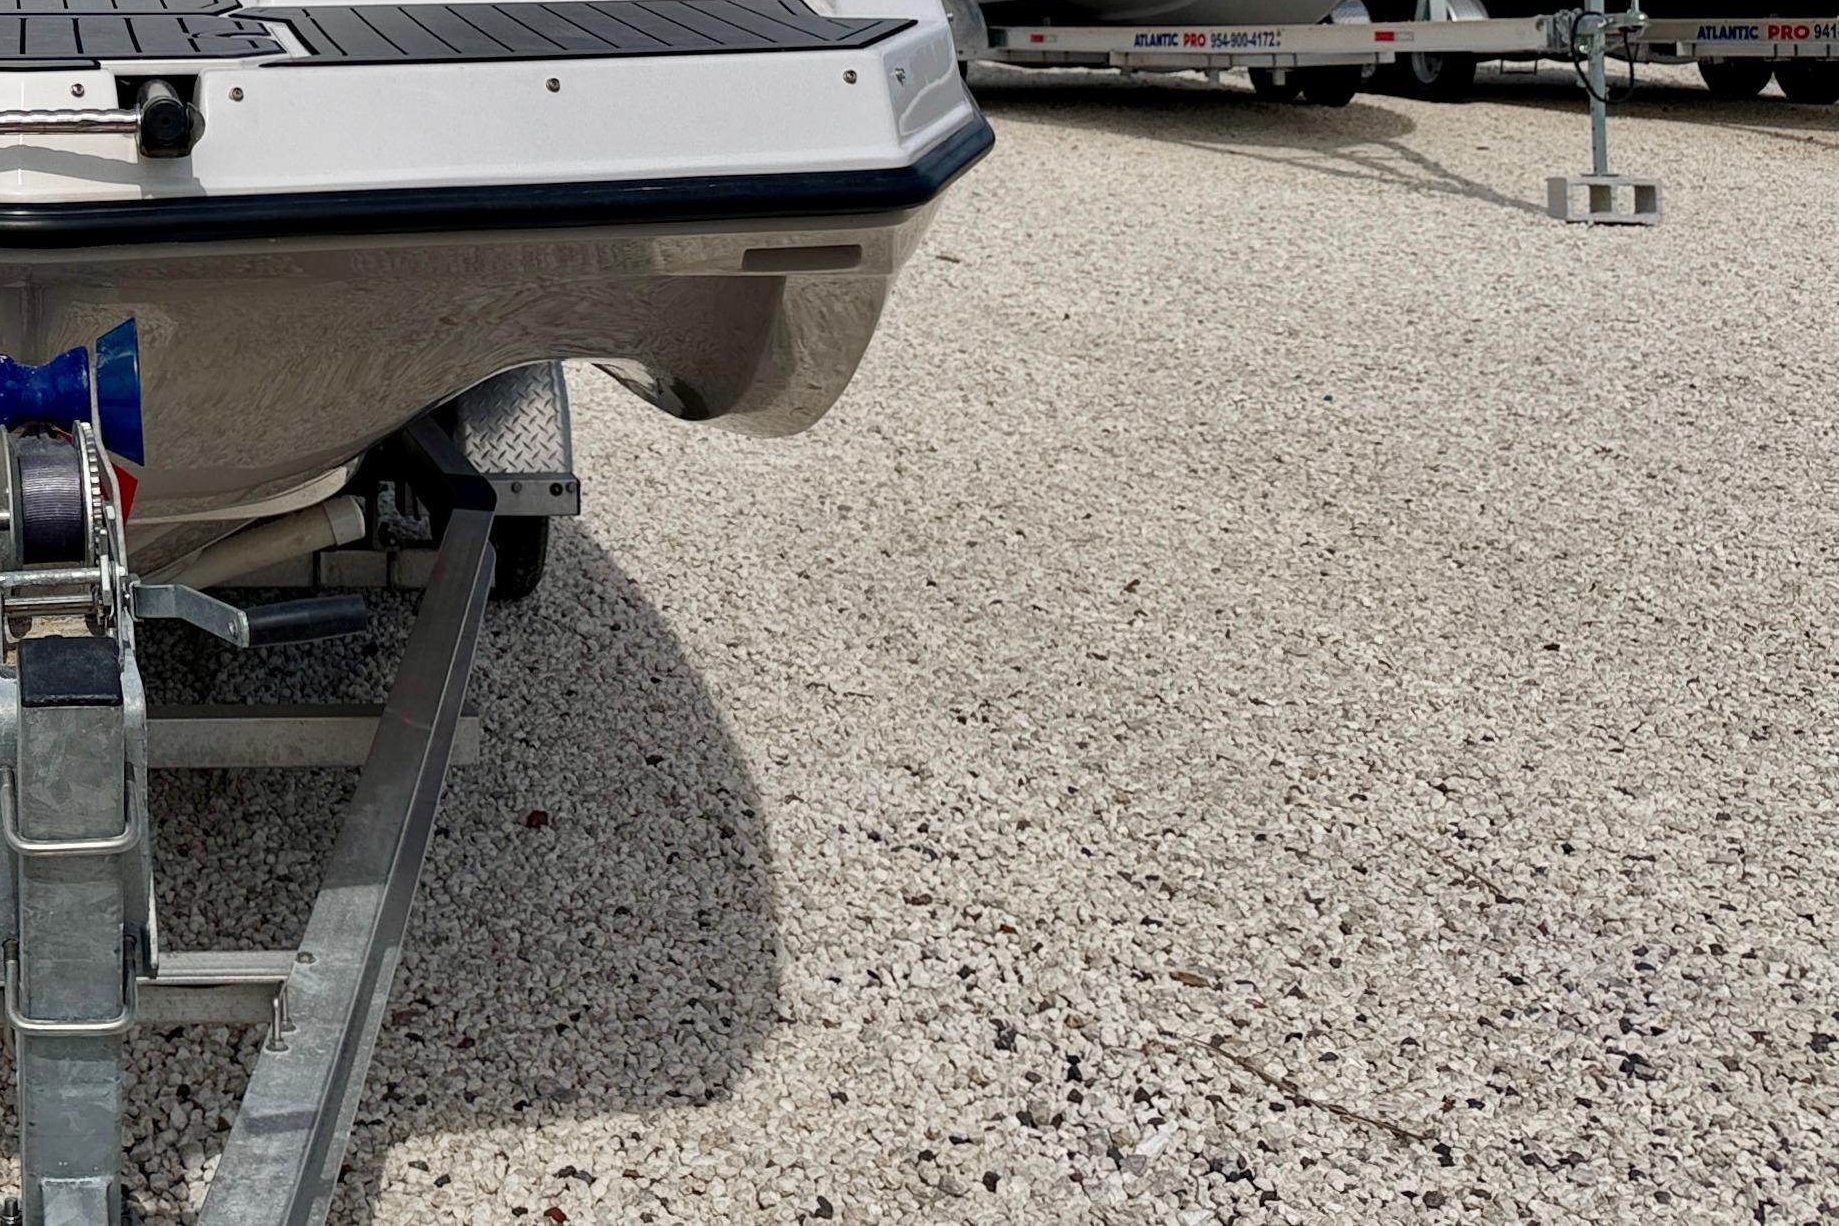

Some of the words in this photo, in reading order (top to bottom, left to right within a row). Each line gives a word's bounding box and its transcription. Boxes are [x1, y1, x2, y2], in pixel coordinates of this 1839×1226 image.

[1697, 25, 1759, 40] ATLANTIC
[1767, 24, 1810, 40] PRO
[1134, 33, 1178, 47] ATLANTIC
[1183, 33, 1206, 47] PRO
